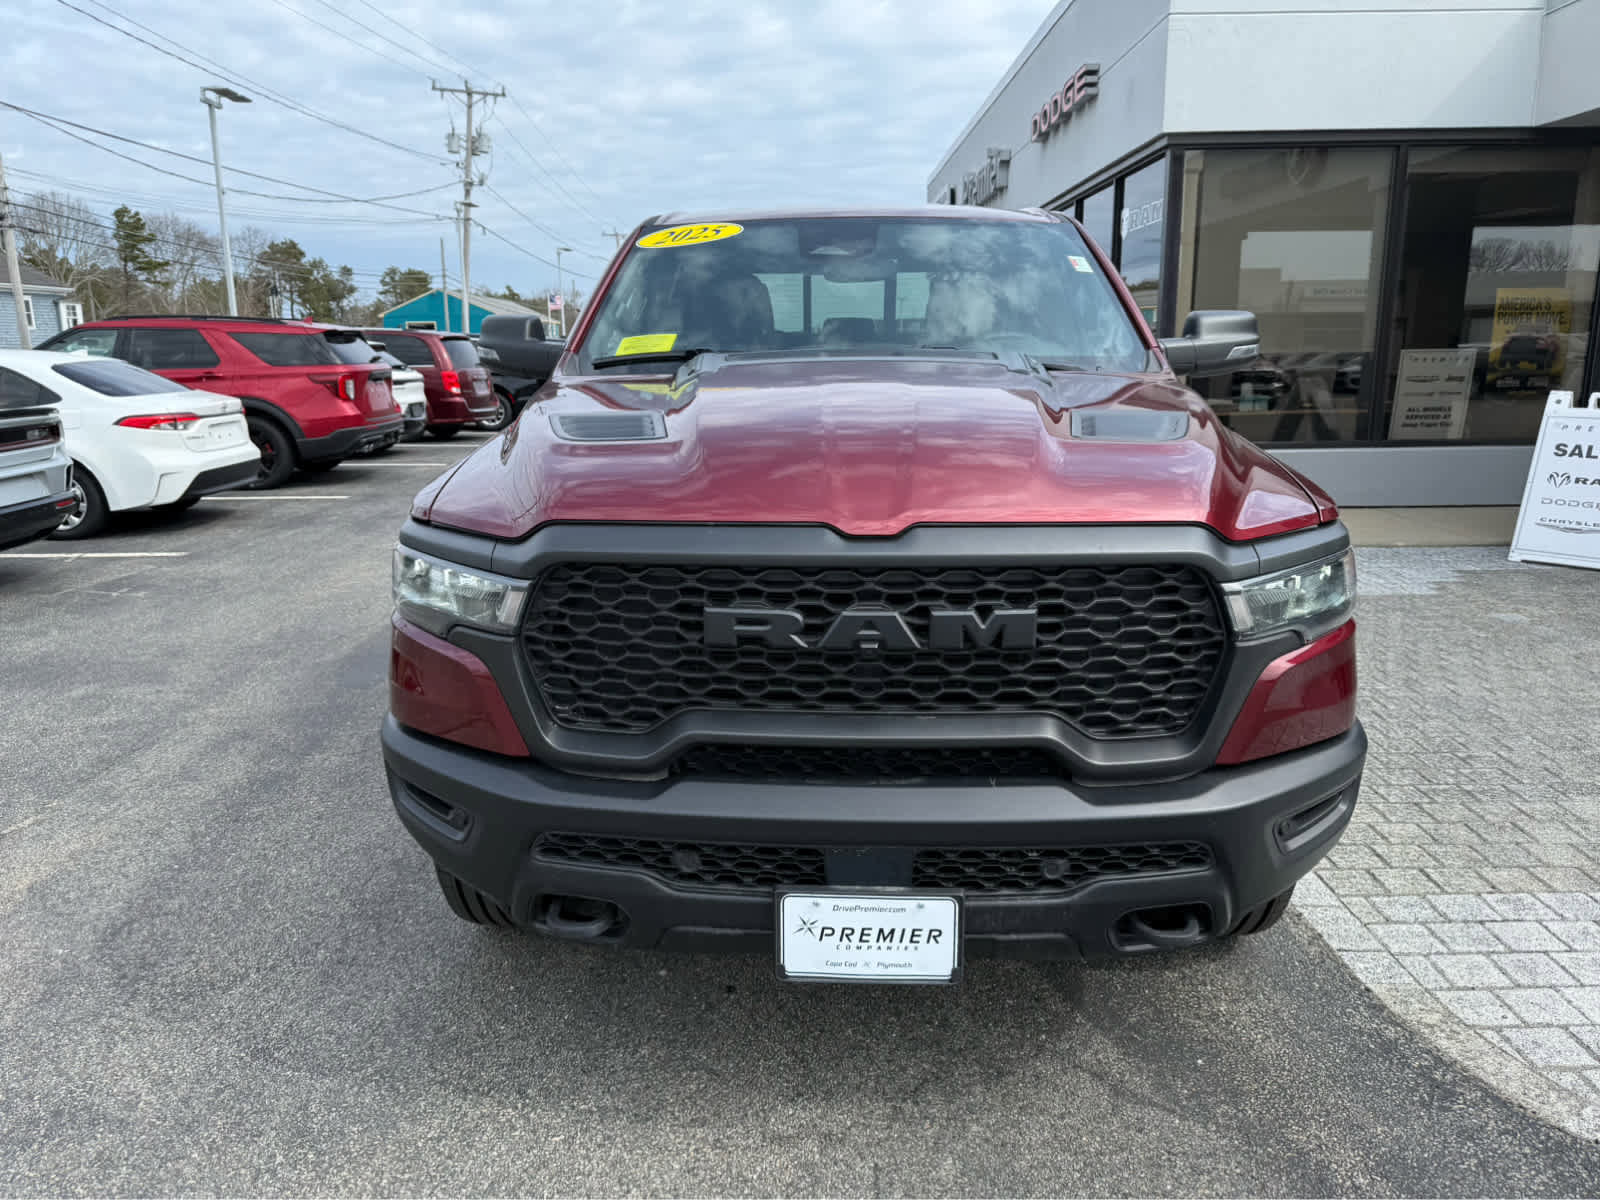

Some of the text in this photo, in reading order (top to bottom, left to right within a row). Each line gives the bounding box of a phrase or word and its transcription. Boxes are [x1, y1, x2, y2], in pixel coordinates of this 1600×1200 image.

[1031, 63, 1100, 143] DODGE
[655, 226, 728, 244] 2025
[704, 606, 1038, 649] RAM
[819, 926, 942, 945] PREMIER
[876, 962, 913, 970] Plymouth
